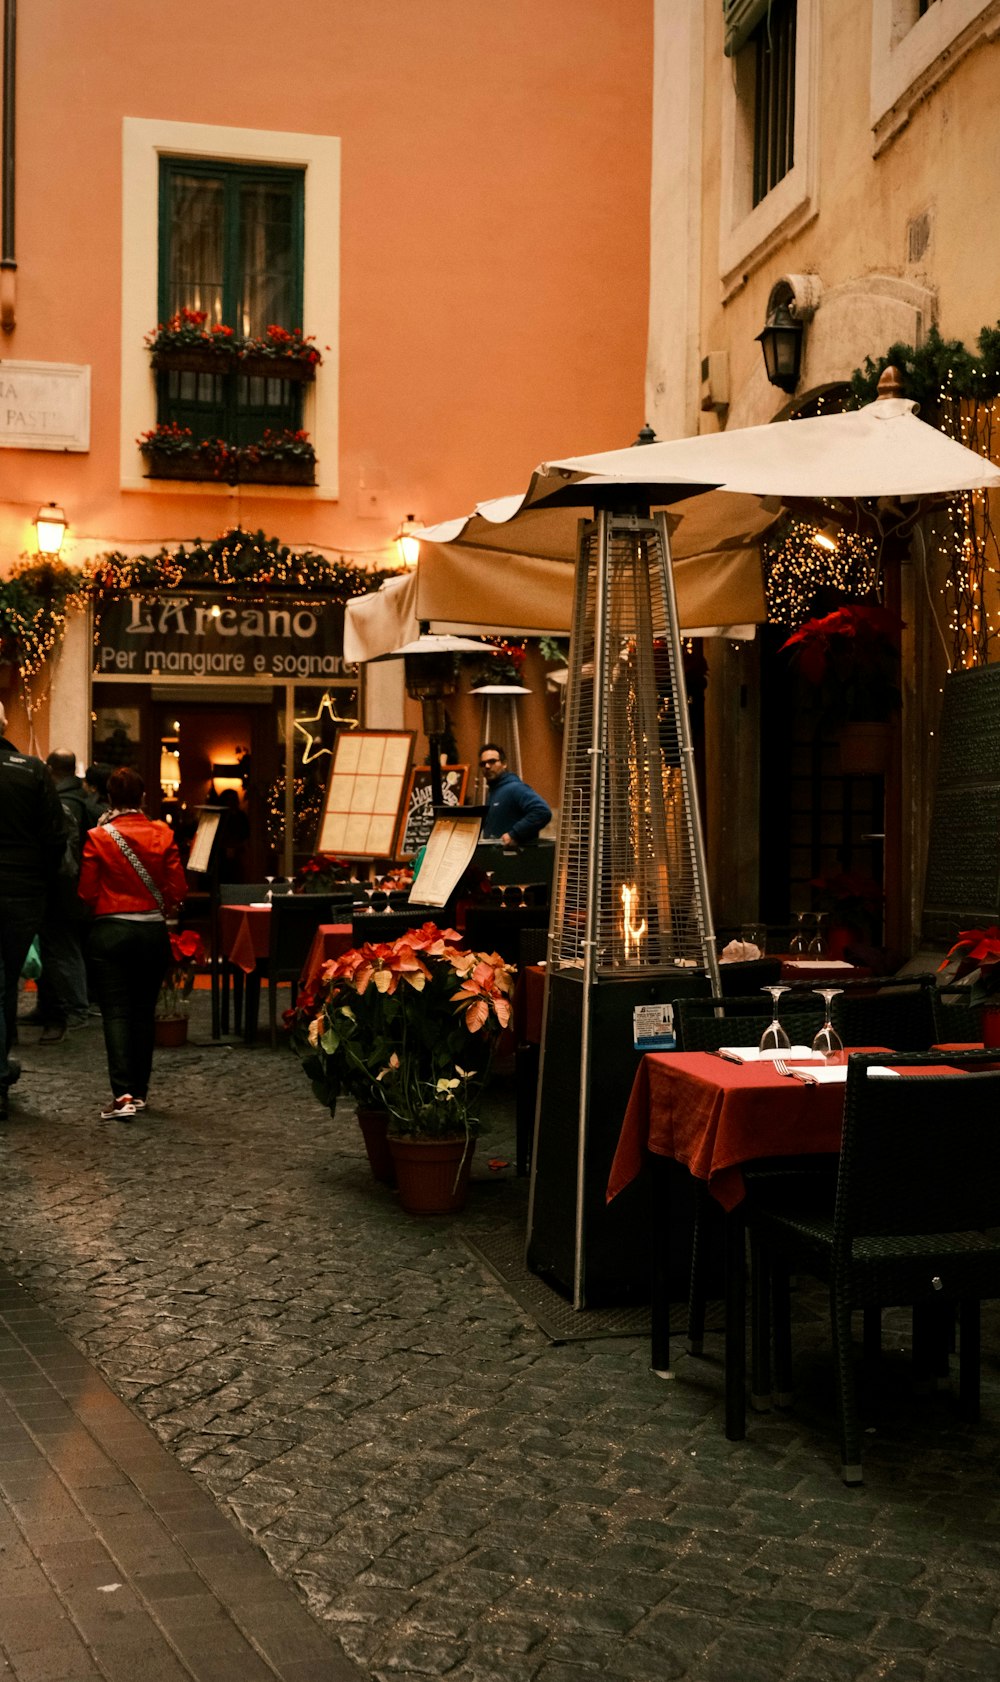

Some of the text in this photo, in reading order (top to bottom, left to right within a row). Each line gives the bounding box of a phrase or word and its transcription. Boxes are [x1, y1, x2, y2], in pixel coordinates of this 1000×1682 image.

[102, 646, 354, 678] Per mangiare e sognare
